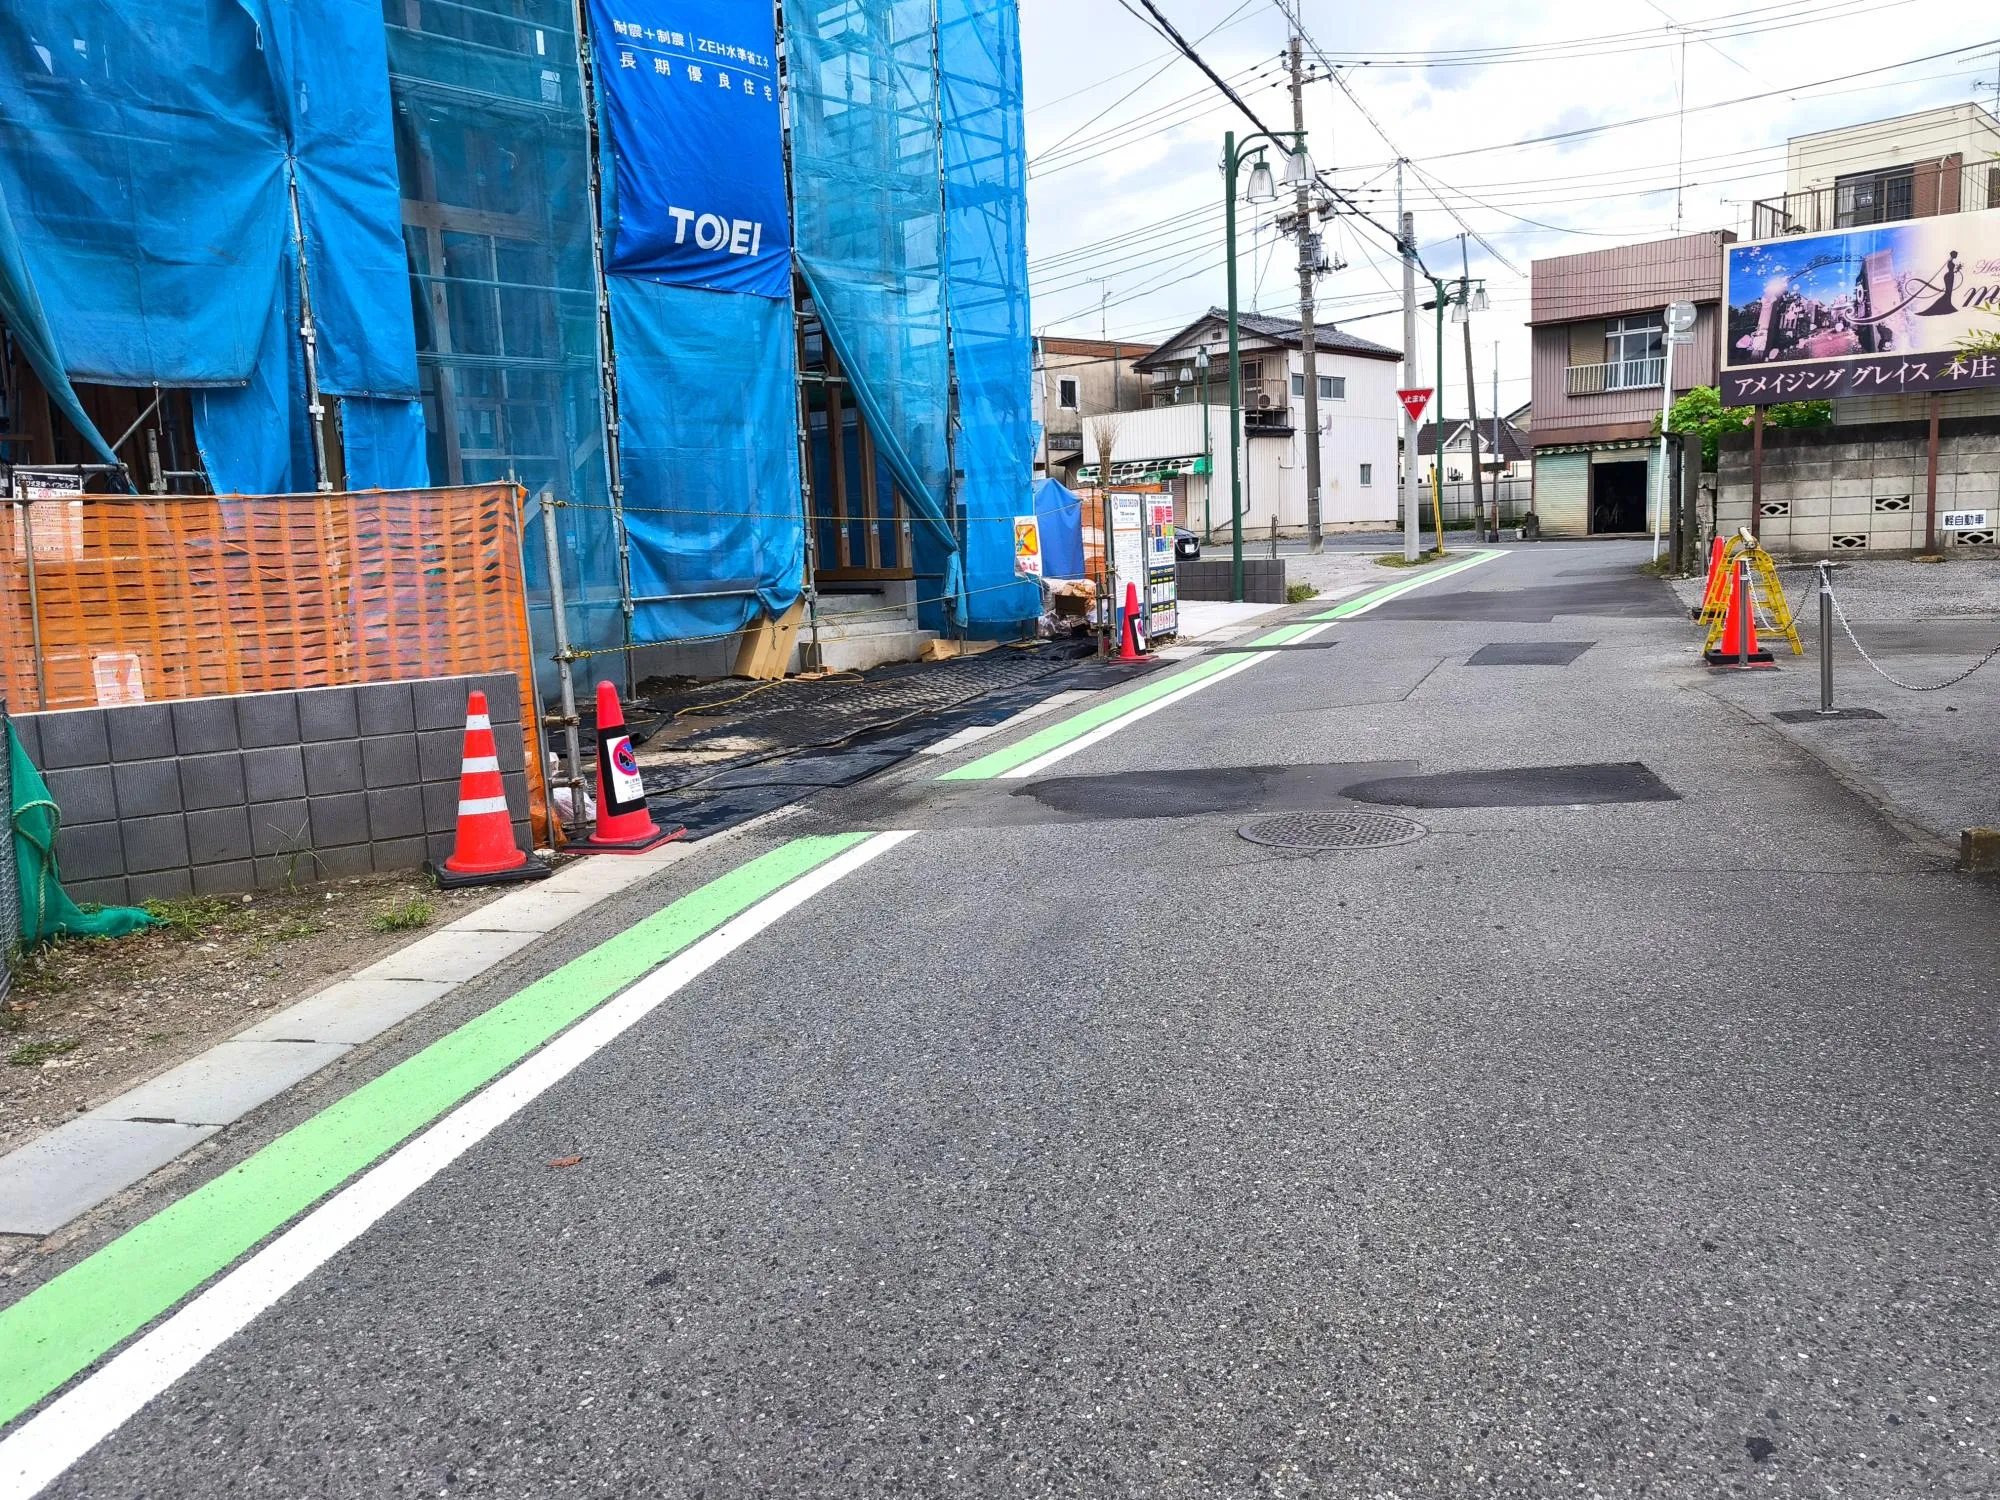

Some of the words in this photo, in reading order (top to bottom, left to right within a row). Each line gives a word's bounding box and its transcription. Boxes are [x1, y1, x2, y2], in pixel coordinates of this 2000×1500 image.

[697, 38, 770, 69] ZEH水準省エネ
[619, 51, 773, 102] 長期優良住宅
[668, 206, 762, 257] TOEI
[1734, 368, 1845, 397] アメイジング
[1851, 361, 1930, 388] グレイス
[1944, 355, 1997, 382] 本庄
[1404, 394, 1427, 404] 止まれ
[1944, 513, 1985, 526] 軽自動車
